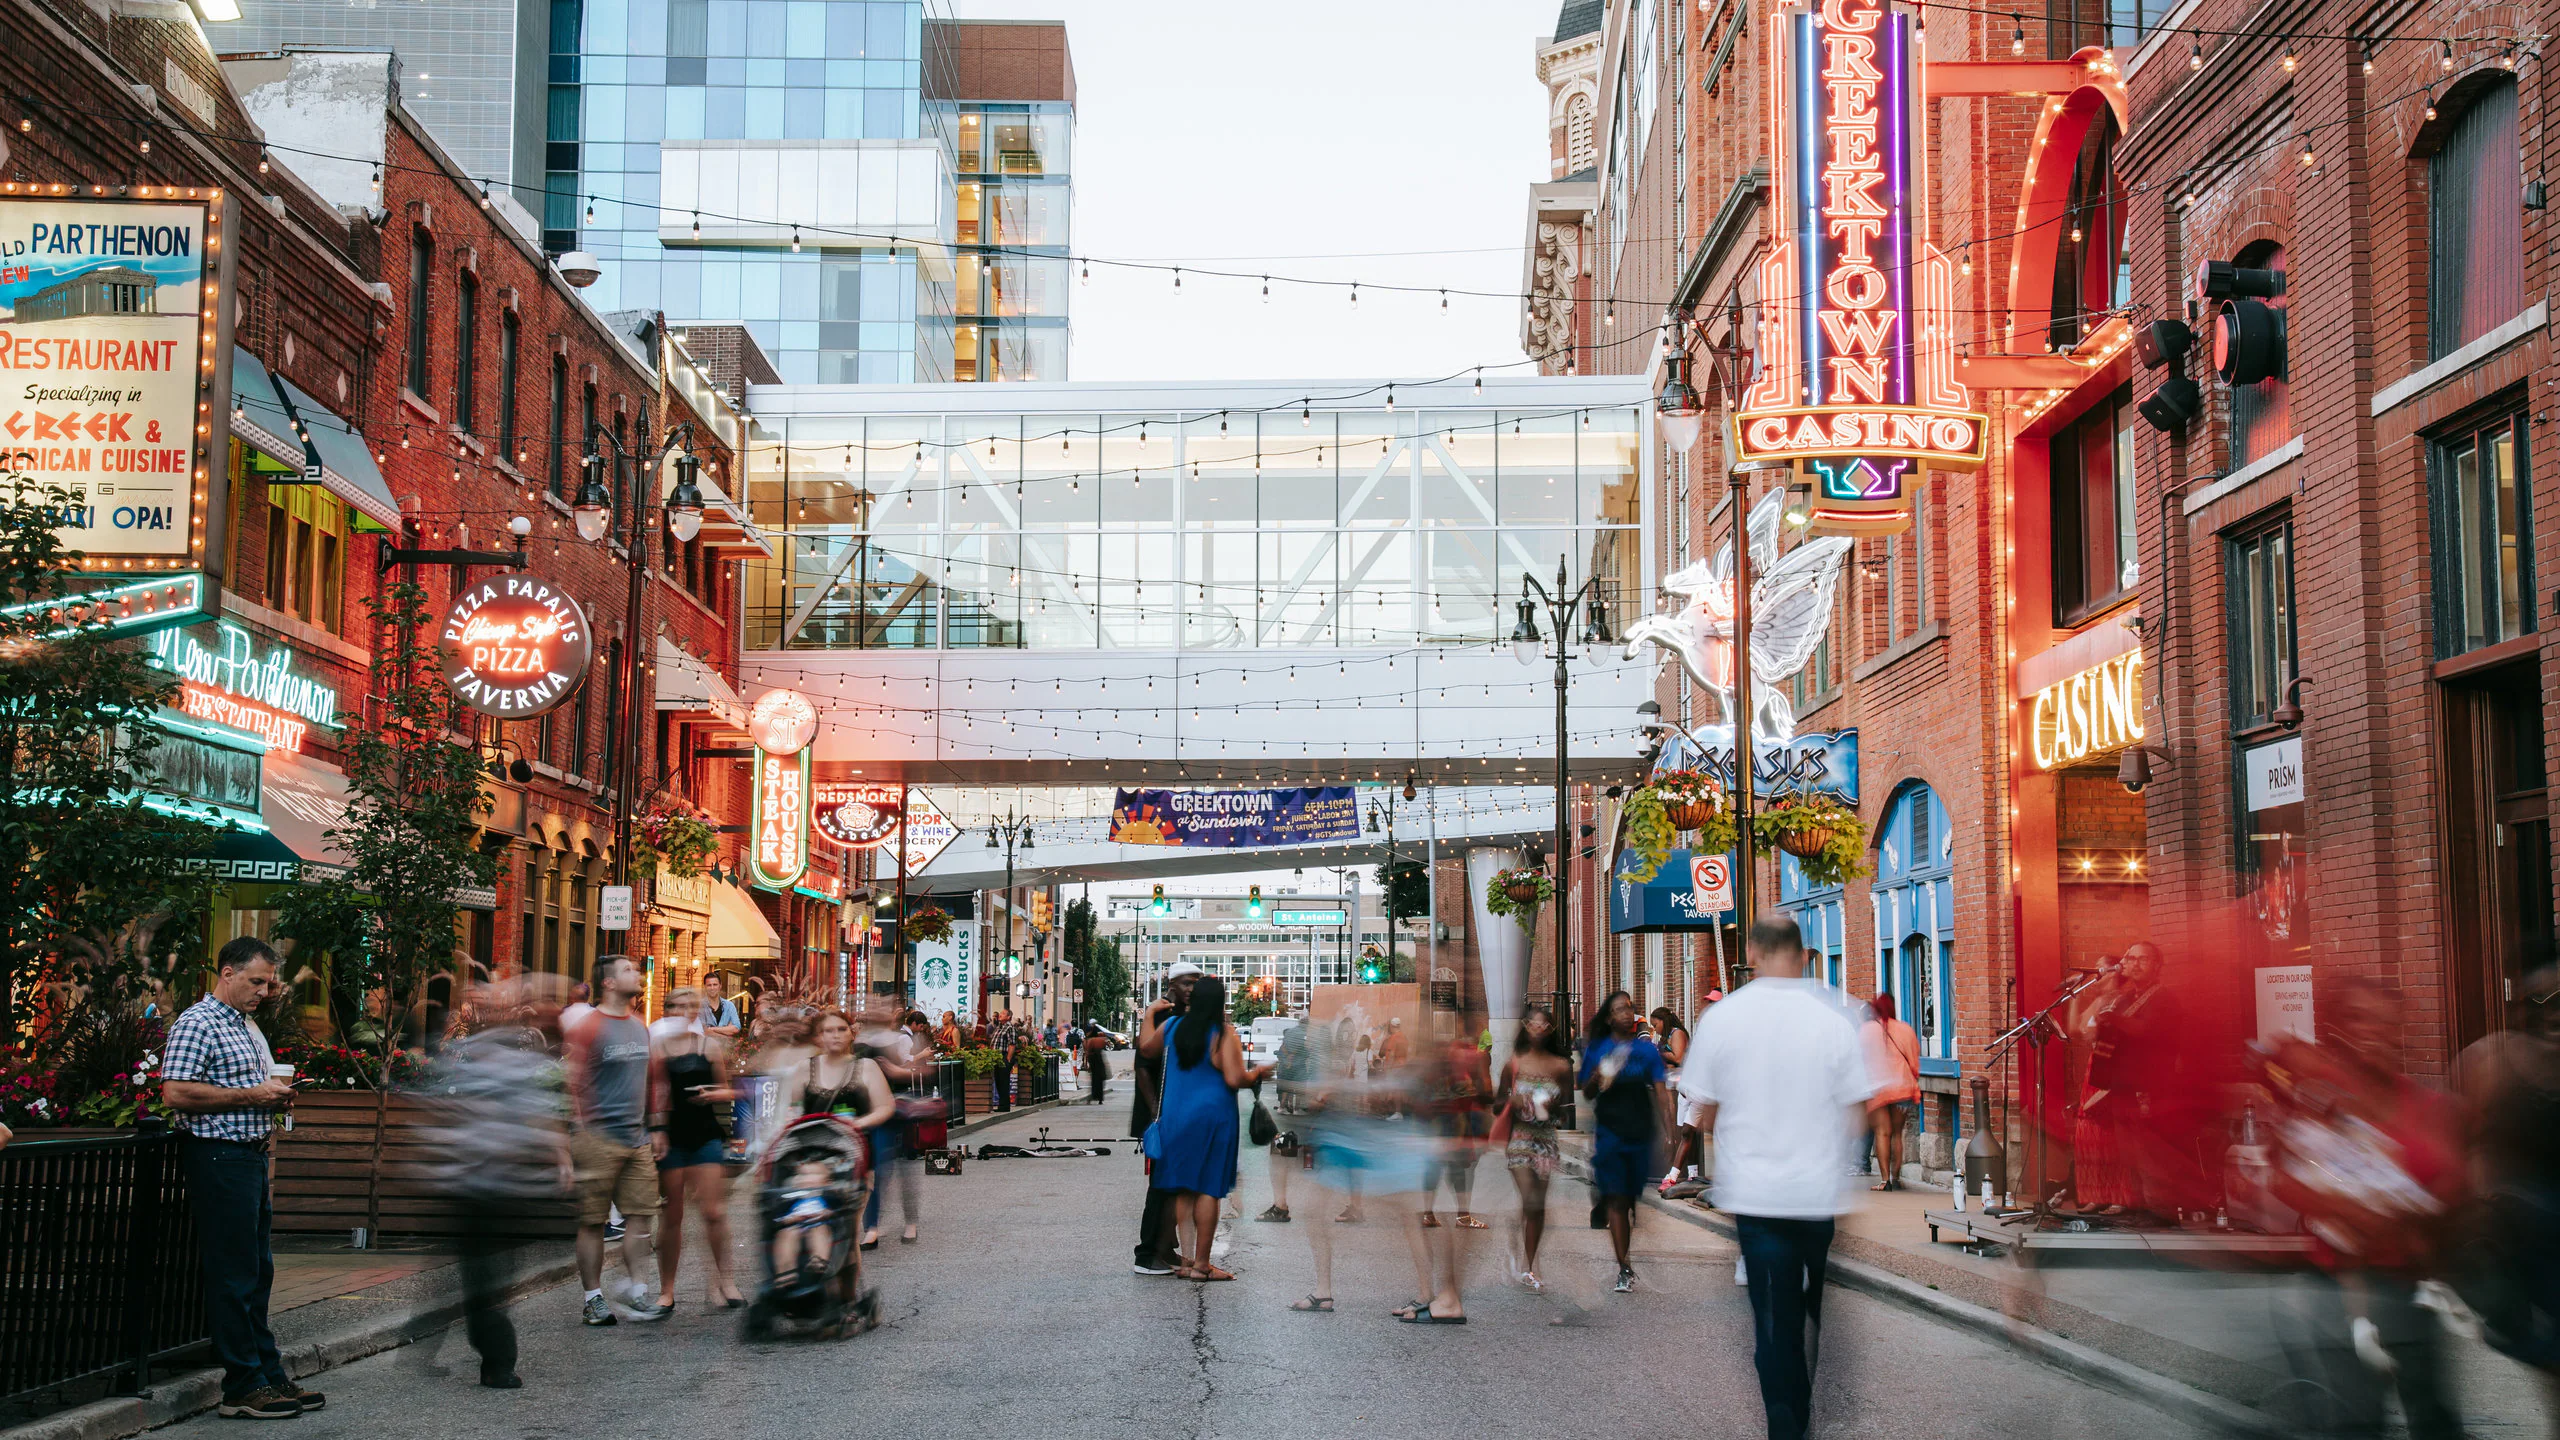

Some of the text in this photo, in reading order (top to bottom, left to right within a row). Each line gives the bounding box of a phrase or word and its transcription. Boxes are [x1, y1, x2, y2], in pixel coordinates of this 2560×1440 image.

[1819, 0, 1898, 403] GREEKTOWN
[0, 223, 190, 258] LD PARTHENON
[0, 265, 30, 285] EW
[0, 330, 178, 371] RESTAURANT
[24, 384, 142, 407] Specializing in
[4, 410, 162, 443] GREEK &
[1750, 413, 1974, 451] CASINO
[0, 447, 186, 473] MERICAN CUISINE
[112, 506, 173, 530] OPA!
[445, 579, 579, 643] PIZZA PAPALIS
[473, 646, 545, 673] PIZZA
[453, 667, 569, 710] TAVERNA
[2268, 763, 2296, 790] PRISM
[818, 791, 898, 803] REDSMOKE
[1170, 794, 1273, 812] GREEKTOWN
[761, 759, 799, 873] STEAK HOUSE
[1177, 813, 1265, 832] at Sundown
[922, 827, 951, 836] WINE
[1299, 913, 1338, 922] Antoine
